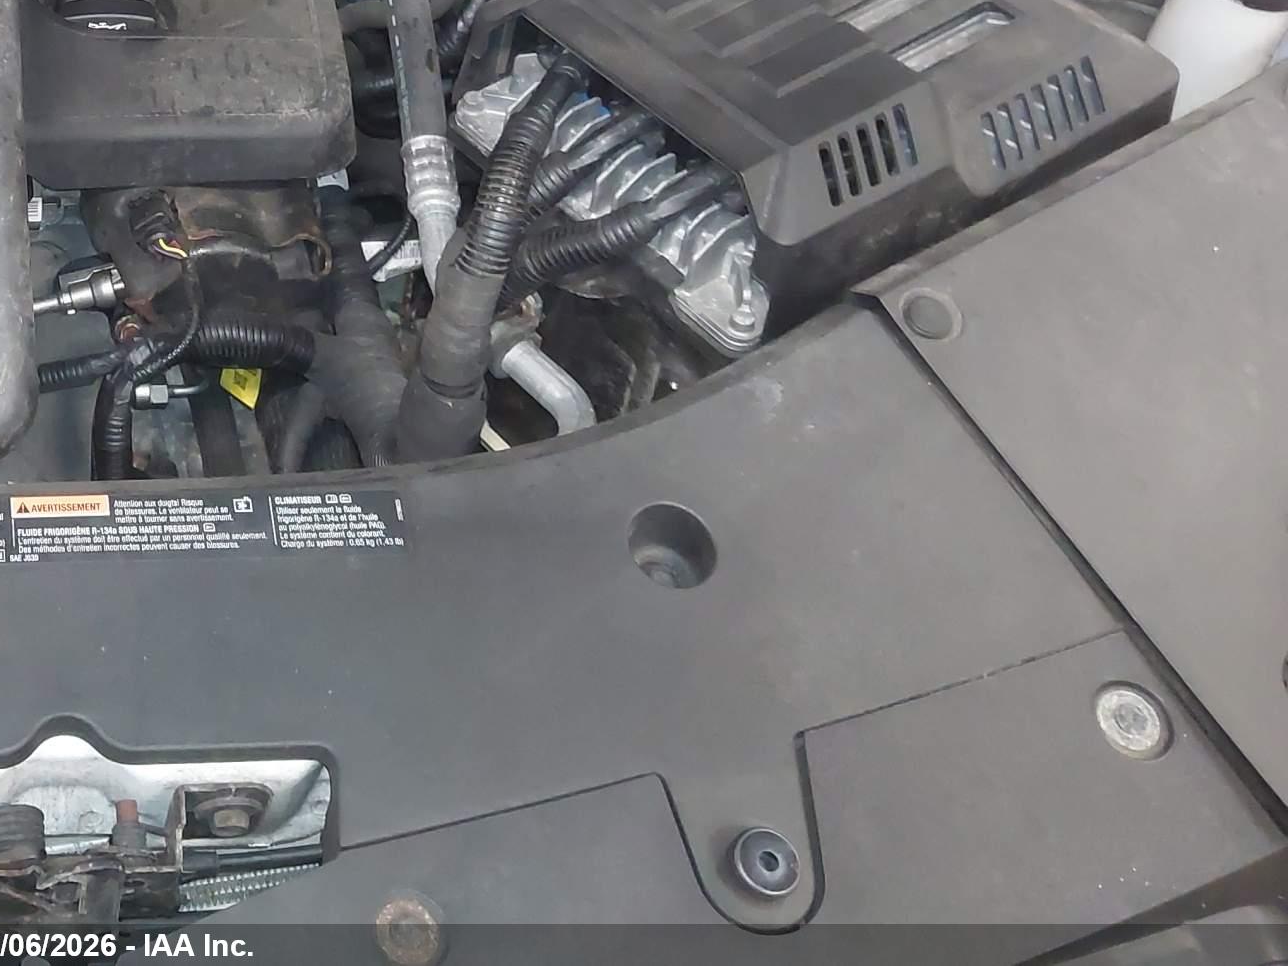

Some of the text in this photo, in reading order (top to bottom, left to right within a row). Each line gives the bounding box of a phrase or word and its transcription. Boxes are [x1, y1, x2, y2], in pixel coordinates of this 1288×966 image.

[181, 499, 203, 507] Risque
[275, 496, 322, 504] CLIMATISEUR
[32, 503, 100, 512] AVERTISSEMENT
[44, 527, 90, 536] FRIGORIGÈNE
[92, 527, 117, 535] R-134a
[164, 525, 199, 533] PRESSION
[290, 532, 317, 540] système
[18, 537, 53, 545] L'entretien
[64, 536, 91, 545] système
[281, 540, 304, 548] Charge
[316, 540, 344, 548] système
[395, 538, 404, 546] lb)
[33, 545, 65, 553] méthodes
[9, 554, 22, 562] SAE
